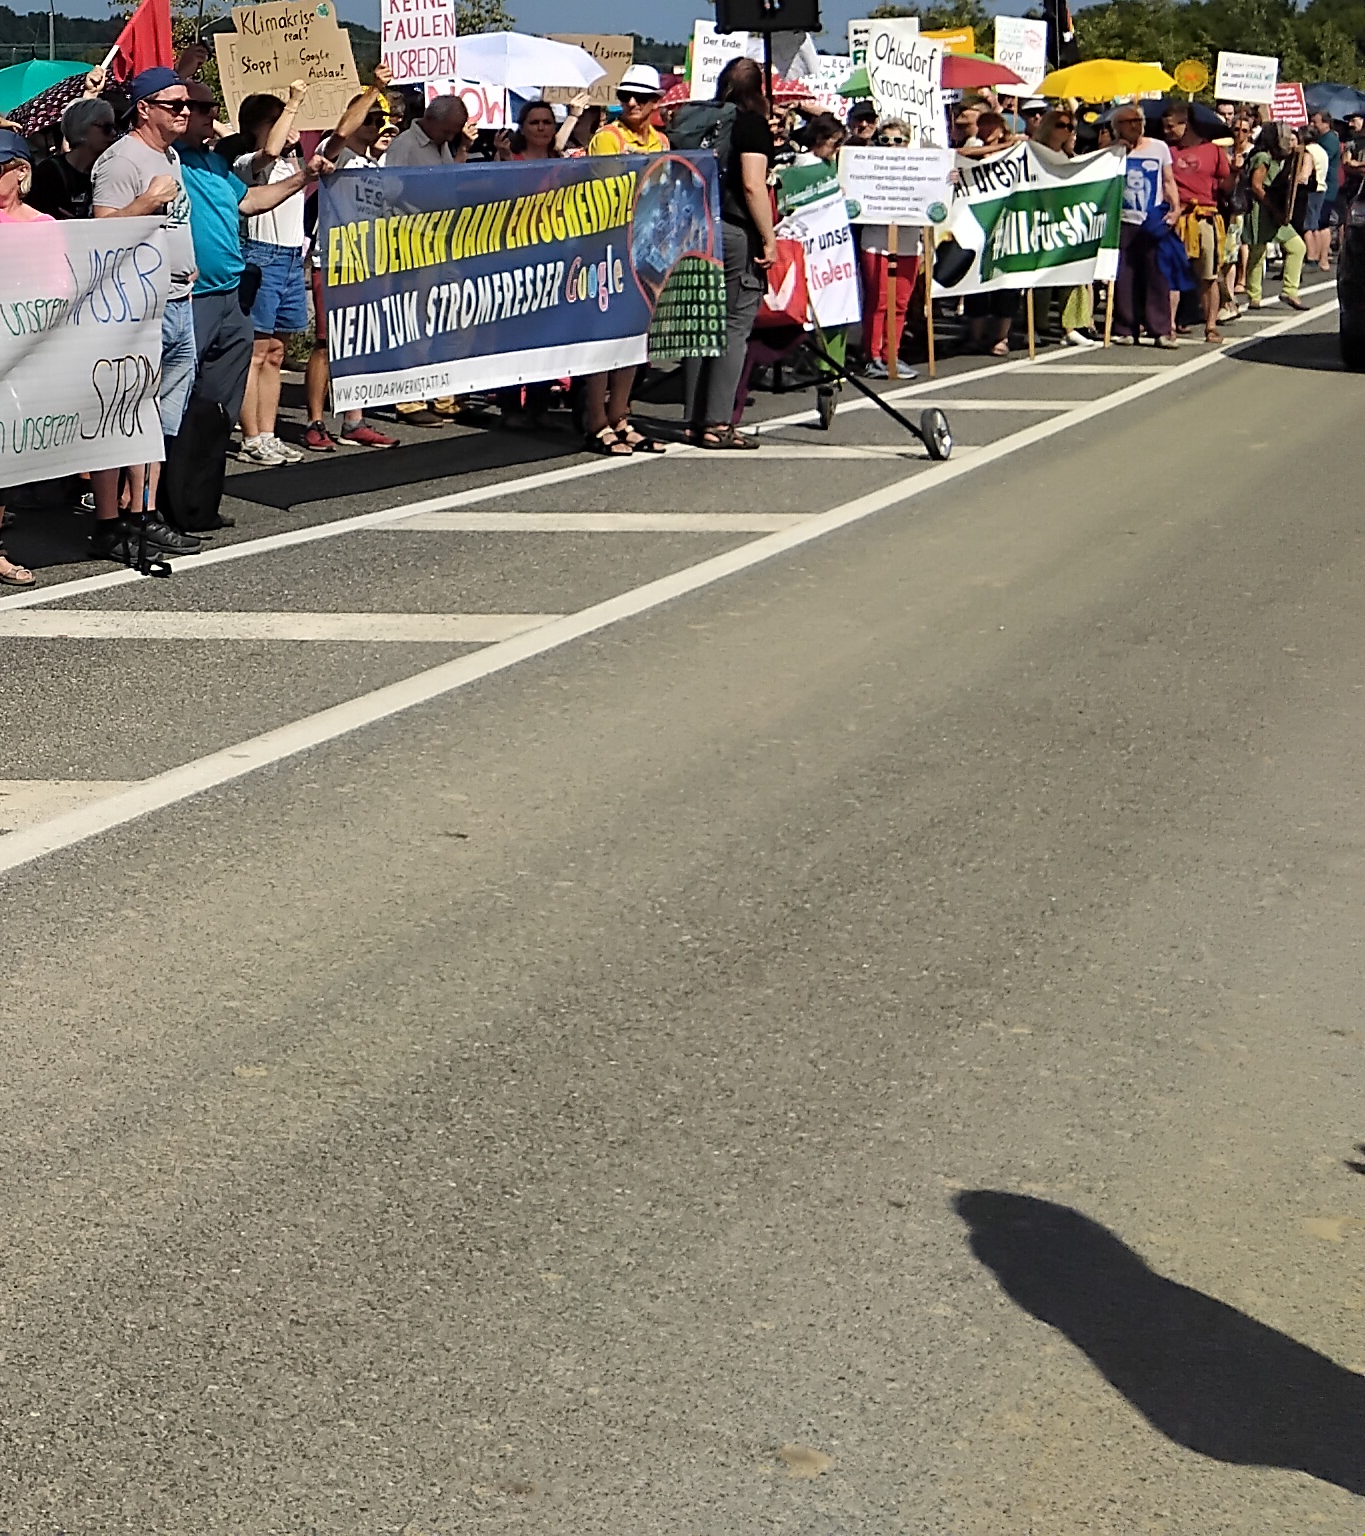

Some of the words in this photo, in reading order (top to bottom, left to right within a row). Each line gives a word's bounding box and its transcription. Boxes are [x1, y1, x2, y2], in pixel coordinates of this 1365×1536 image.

[240, 8, 315, 35] Klimakrise
[284, 27, 309, 42] real!
[383, 13, 455, 42] FAULEN
[703, 36, 718, 46] Der
[722, 38, 741, 48] Erde
[241, 51, 279, 75] Stoppt
[383, 46, 456, 79] AUSREDEN
[702, 56, 722, 66] geht
[328, 221, 370, 286] ERST
[375, 209, 455, 274] DENKEN
[451, 200, 510, 260] DANN
[506, 171, 636, 250] ENTSCHEIDEN!
[0, 296, 71, 337] unserem
[64, 242, 162, 326] WASSER
[329, 302, 381, 362] NEIN
[383, 290, 420, 349] ZUM
[426, 261, 564, 337] STROMFRESSER
[565, 244, 623, 312] Google
[12, 411, 80, 455] unserem
